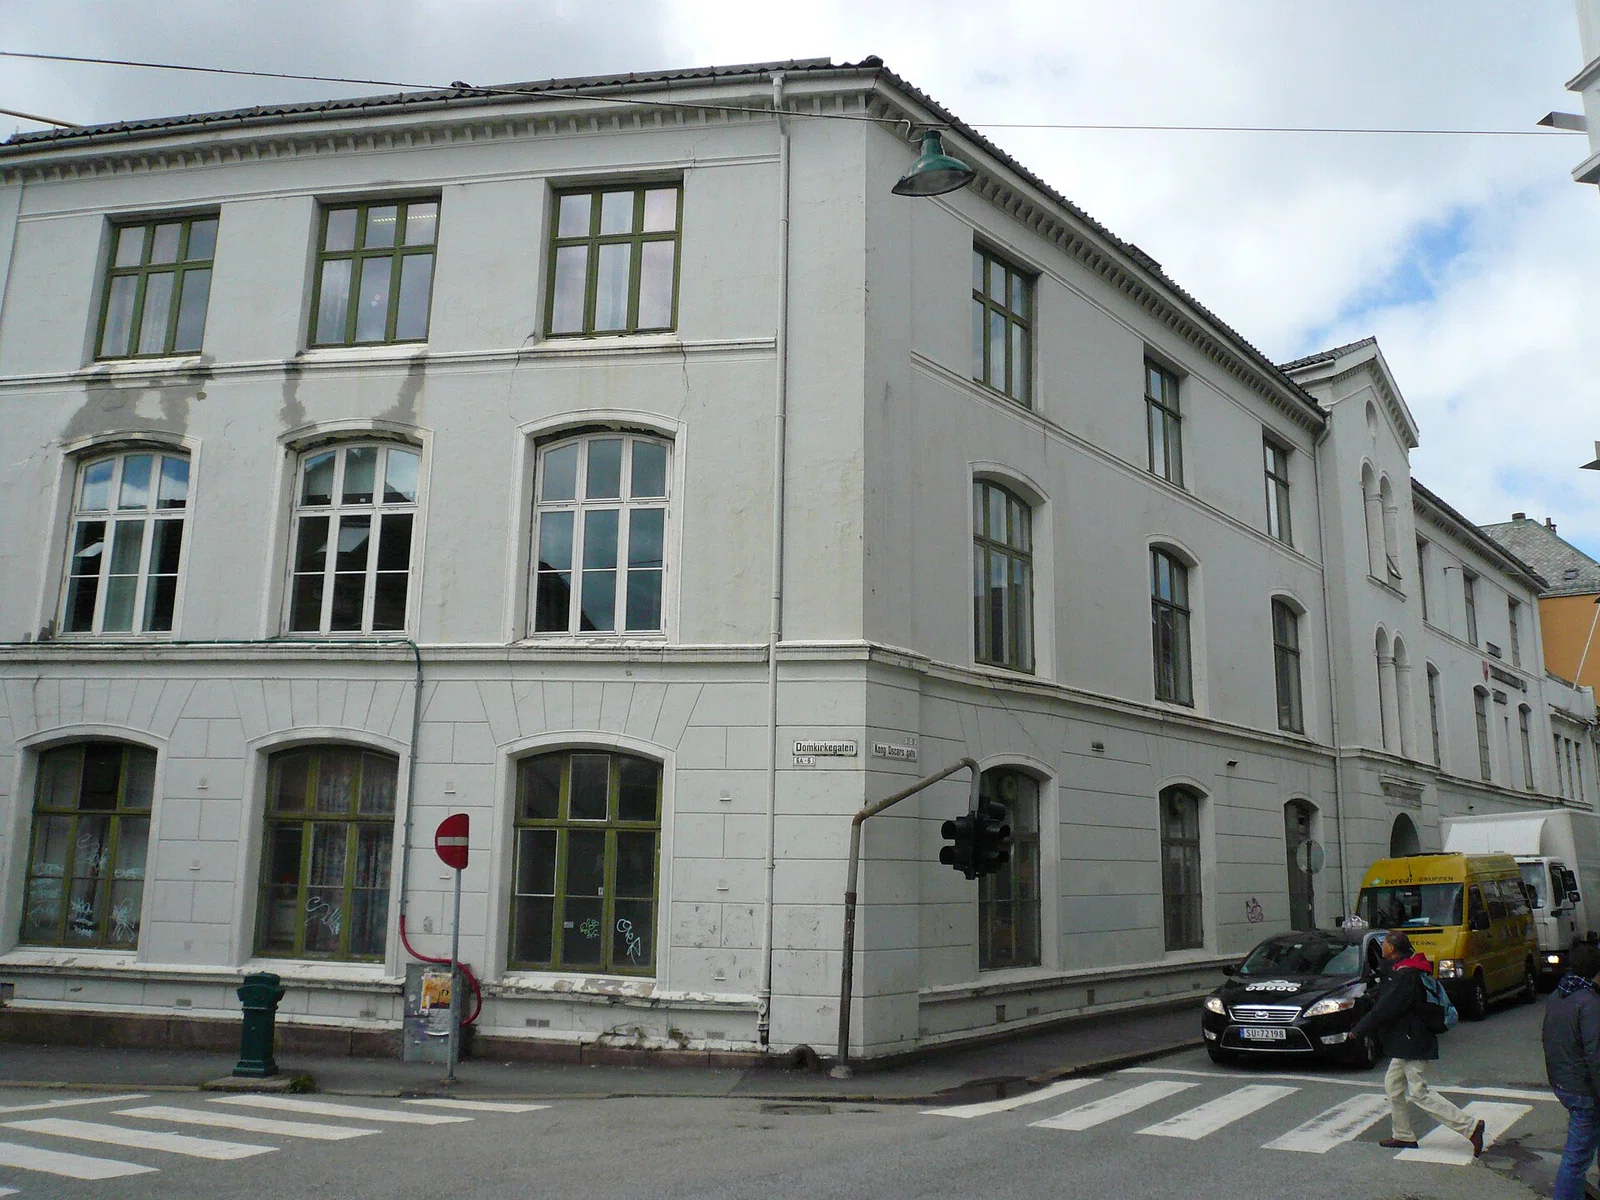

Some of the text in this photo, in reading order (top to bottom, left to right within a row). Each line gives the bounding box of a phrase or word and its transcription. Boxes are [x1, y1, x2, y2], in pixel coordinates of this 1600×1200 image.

[796, 742, 854, 755] Domkirkegaten
[874, 744, 886, 757] Kong
[1246, 1029, 1284, 1038] SU 72198
